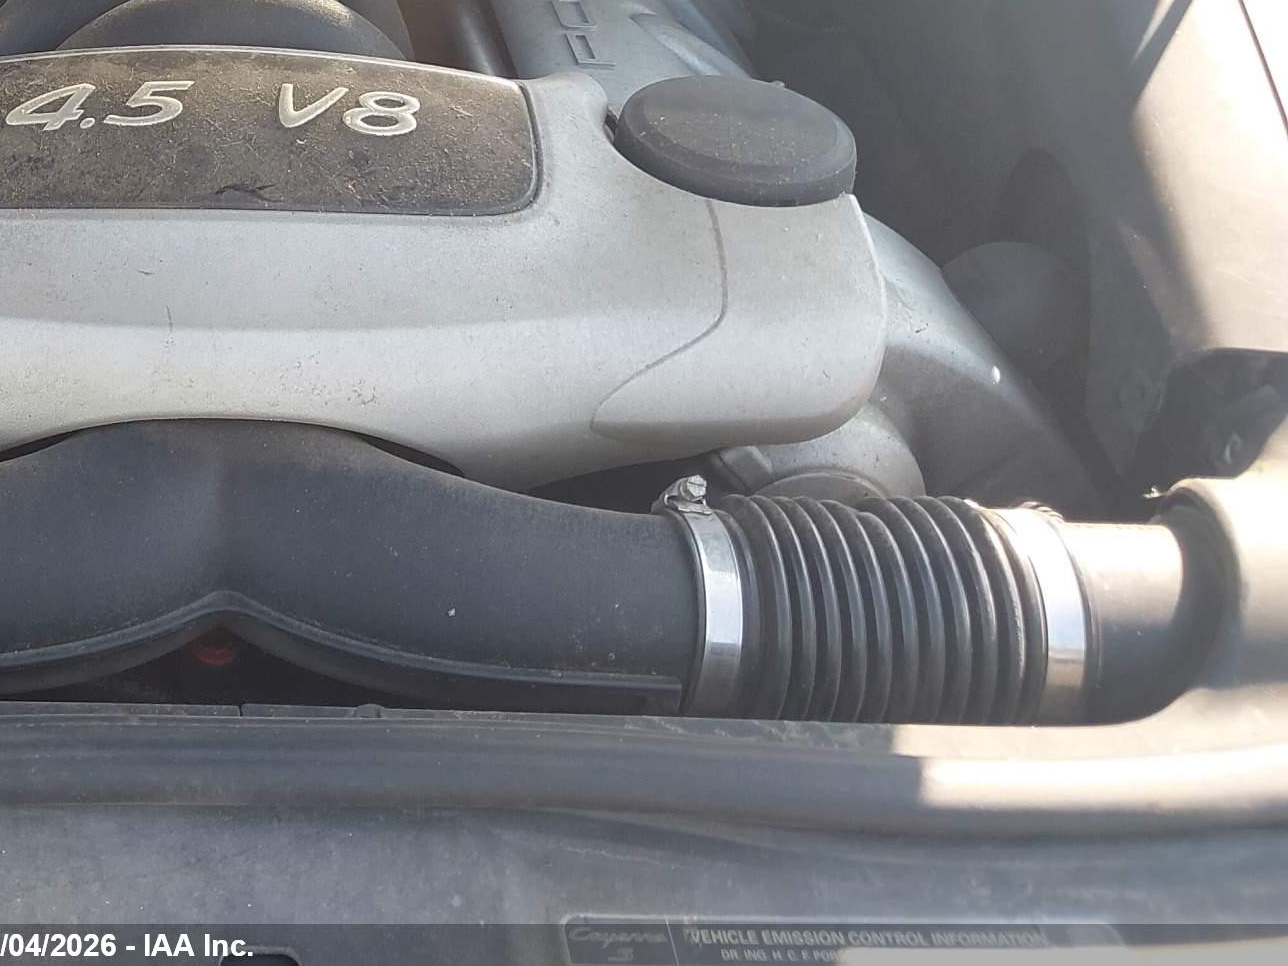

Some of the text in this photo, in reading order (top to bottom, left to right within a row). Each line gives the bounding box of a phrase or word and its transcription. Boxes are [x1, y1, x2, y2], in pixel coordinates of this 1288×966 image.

[5, 80, 421, 135] 4.5 V8
[690, 929, 759, 945] VEHICLE
[761, 930, 845, 946] EMISSION
[848, 930, 930, 947] CONTROL
